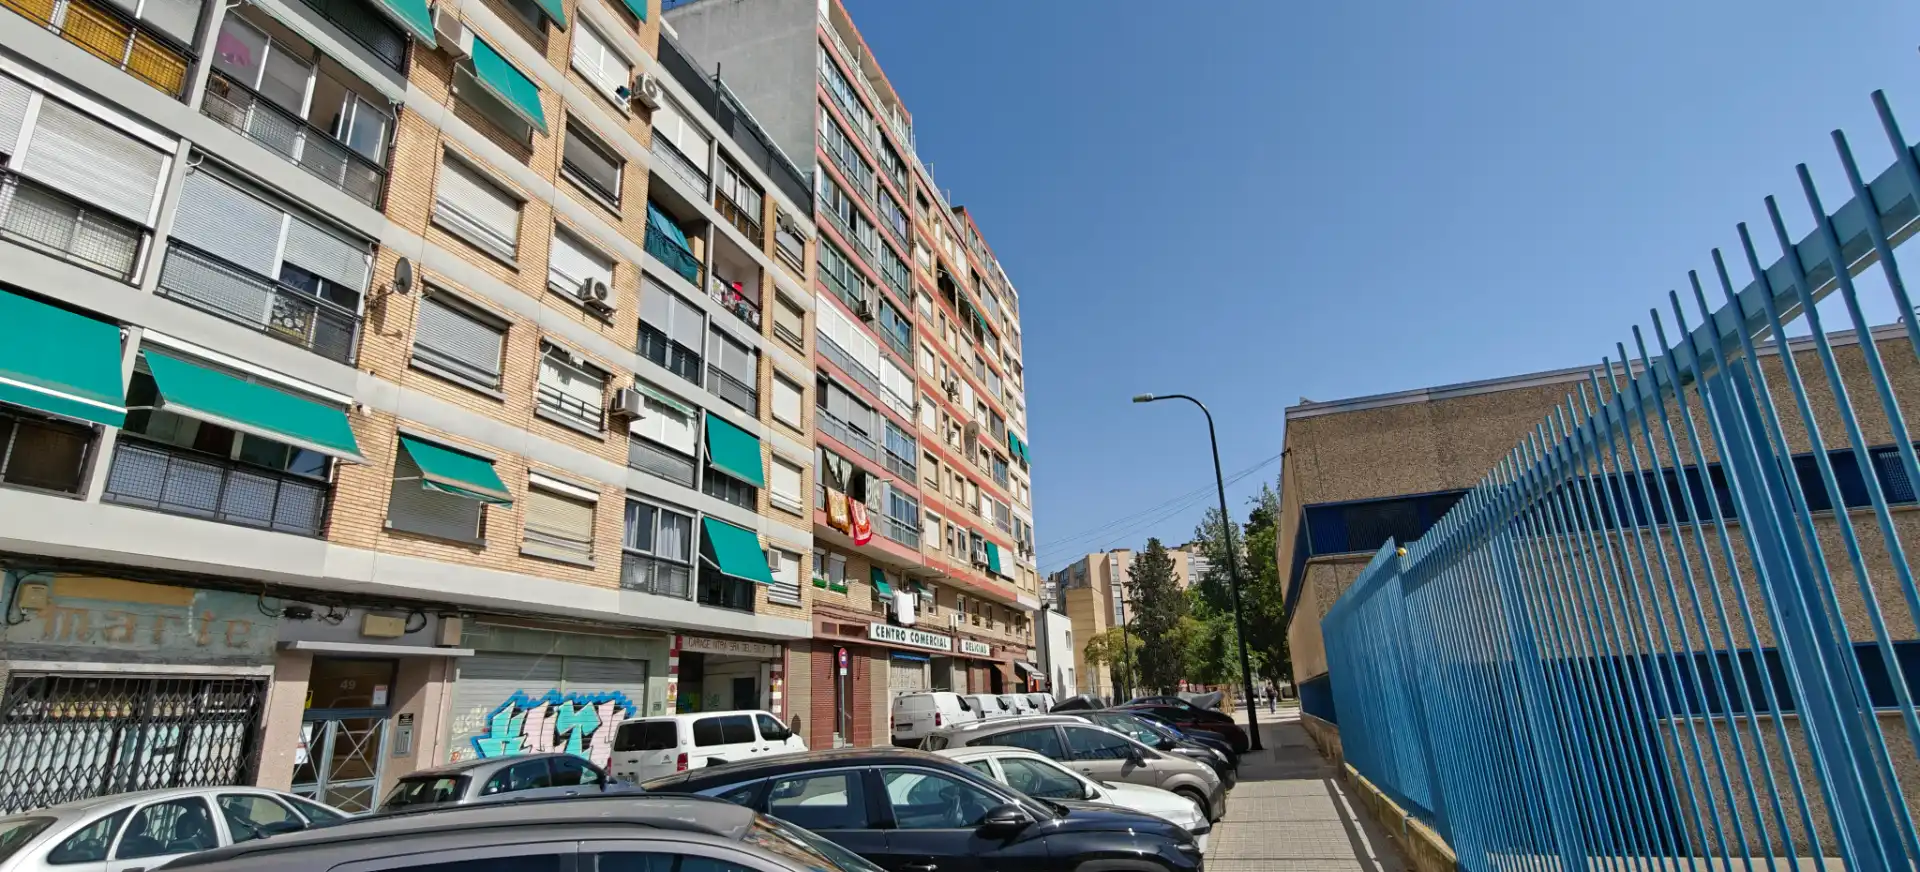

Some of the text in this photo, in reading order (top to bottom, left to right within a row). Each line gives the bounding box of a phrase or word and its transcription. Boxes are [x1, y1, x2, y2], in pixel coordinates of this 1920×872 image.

[875, 624, 947, 648] CENTRO COMERCIAL
[965, 639, 987, 654] DELICIAS
[340, 679, 356, 690] 49
